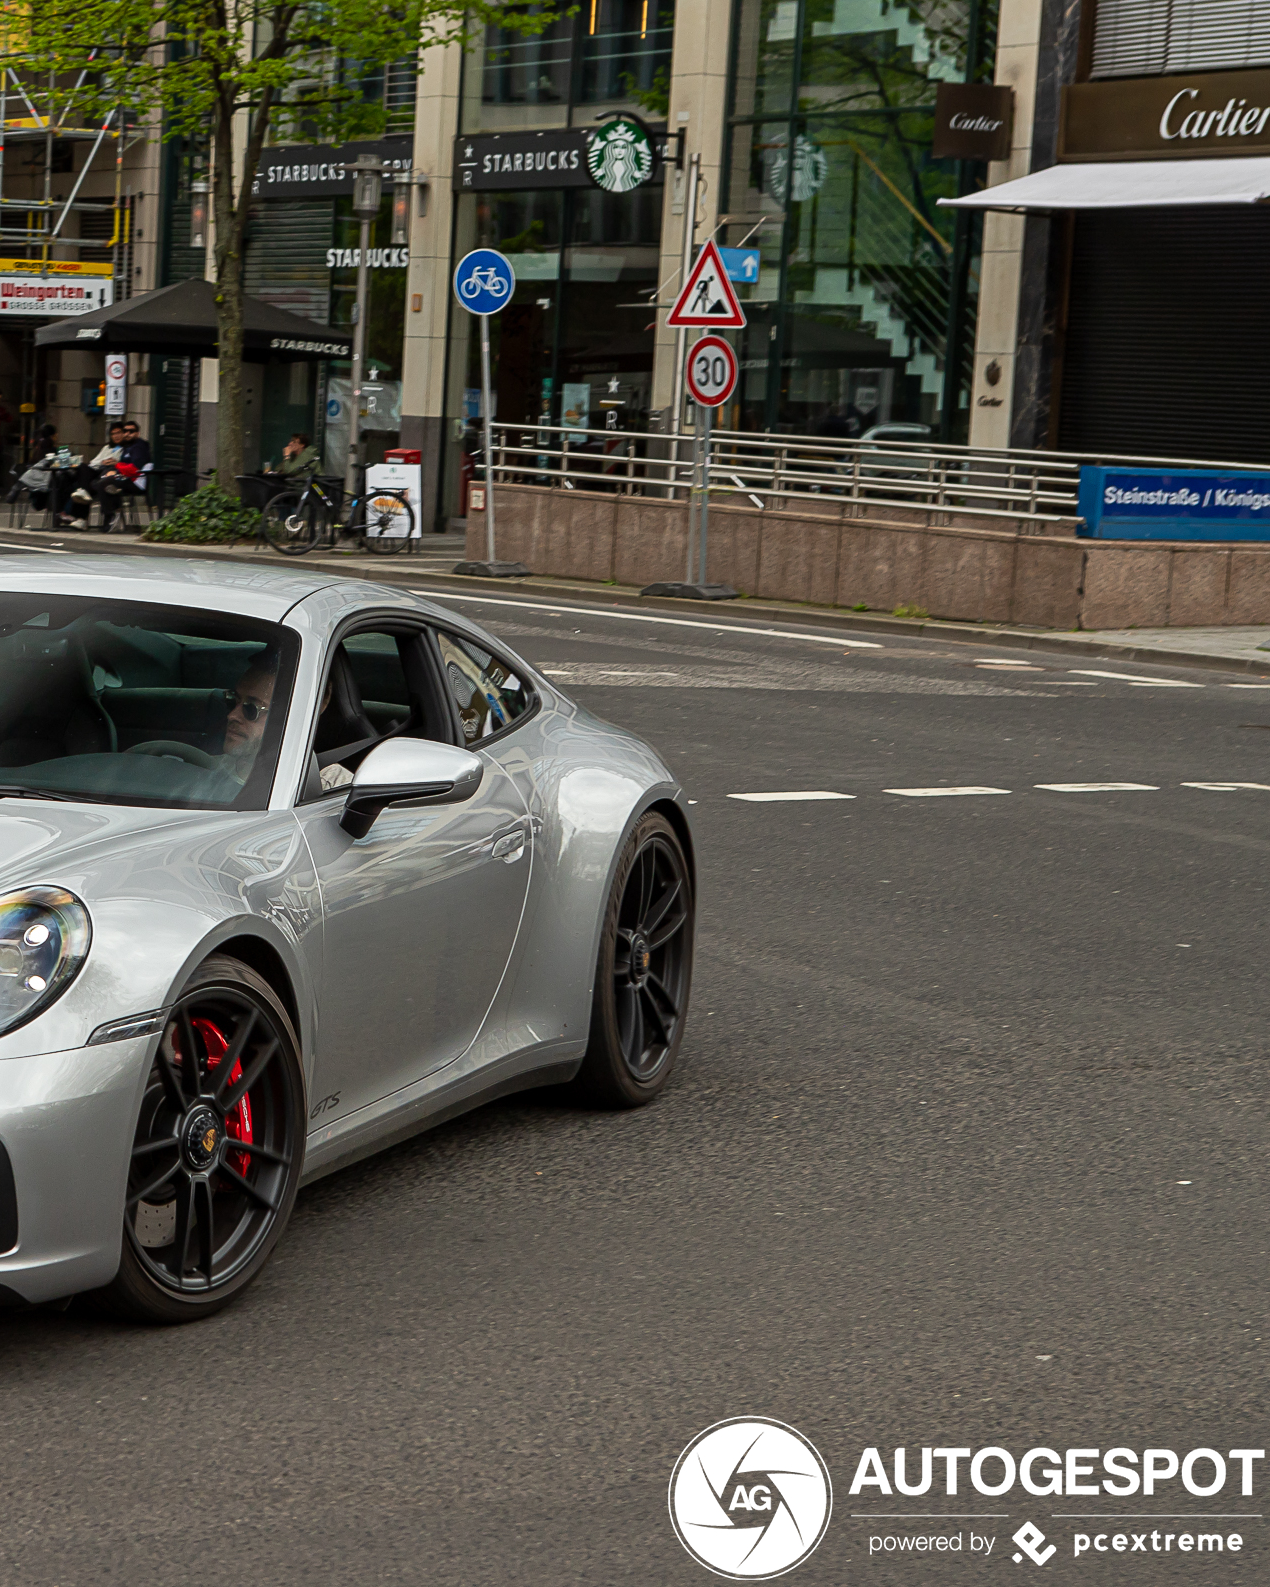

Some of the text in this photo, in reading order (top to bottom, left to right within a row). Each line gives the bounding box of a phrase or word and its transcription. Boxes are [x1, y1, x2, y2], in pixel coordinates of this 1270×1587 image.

[949, 111, 1003, 131] Cartier
[1159, 87, 1270, 139] Cartier
[482, 150, 579, 173] STARBUCKS
[267, 162, 346, 183] STARBUCKS
[462, 171, 473, 186] R
[326, 248, 409, 268] STARBUCKS
[0, 283, 85, 301] Weingarten
[270, 338, 349, 355] STARBUCKS
[695, 356, 726, 387] 30
[605, 410, 618, 430] R
[1104, 486, 1200, 506] Steinstraße
[310, 1090, 342, 1120] GTS
